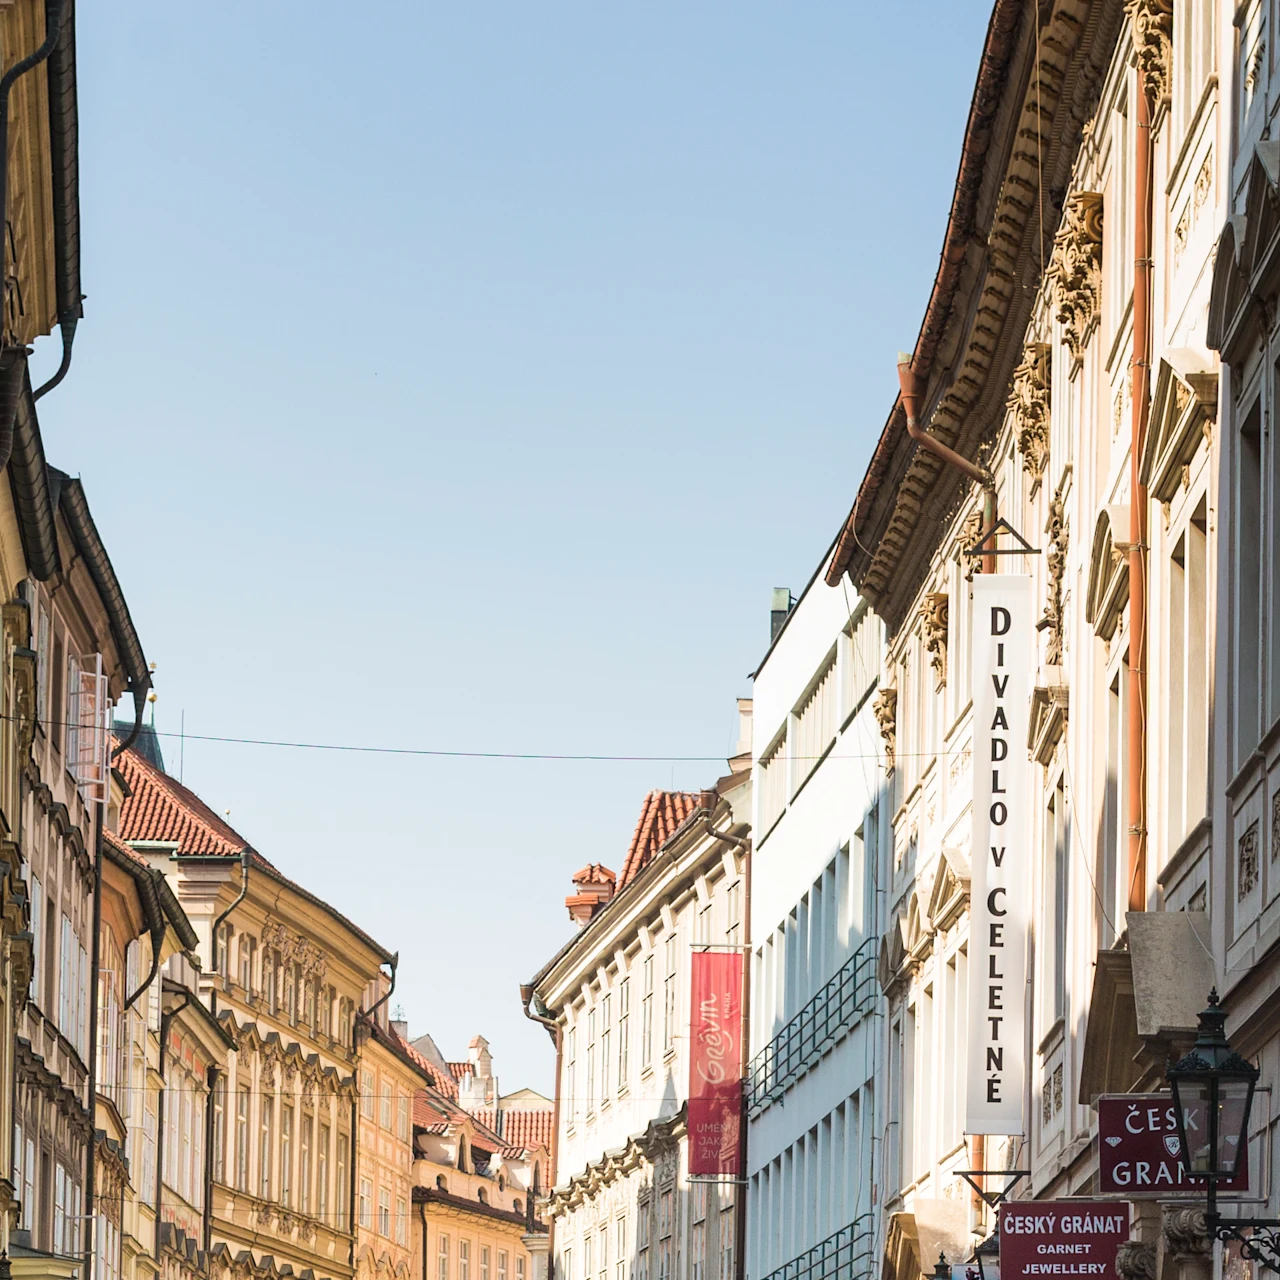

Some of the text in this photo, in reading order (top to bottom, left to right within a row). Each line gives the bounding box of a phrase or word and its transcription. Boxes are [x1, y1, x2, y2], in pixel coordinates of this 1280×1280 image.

[989, 606, 1012, 827] DIVADLO
[985, 886, 1008, 1103] CELETNÉ
[1125, 1104, 1200, 1134] ČESK
[1112, 1160, 1236, 1186] GRANT
[1004, 1211, 1124, 1235] ČESKÝ GRÁNAT
[1036, 1244, 1092, 1255] GARNET
[1021, 1263, 1107, 1275] JEWELLERY
